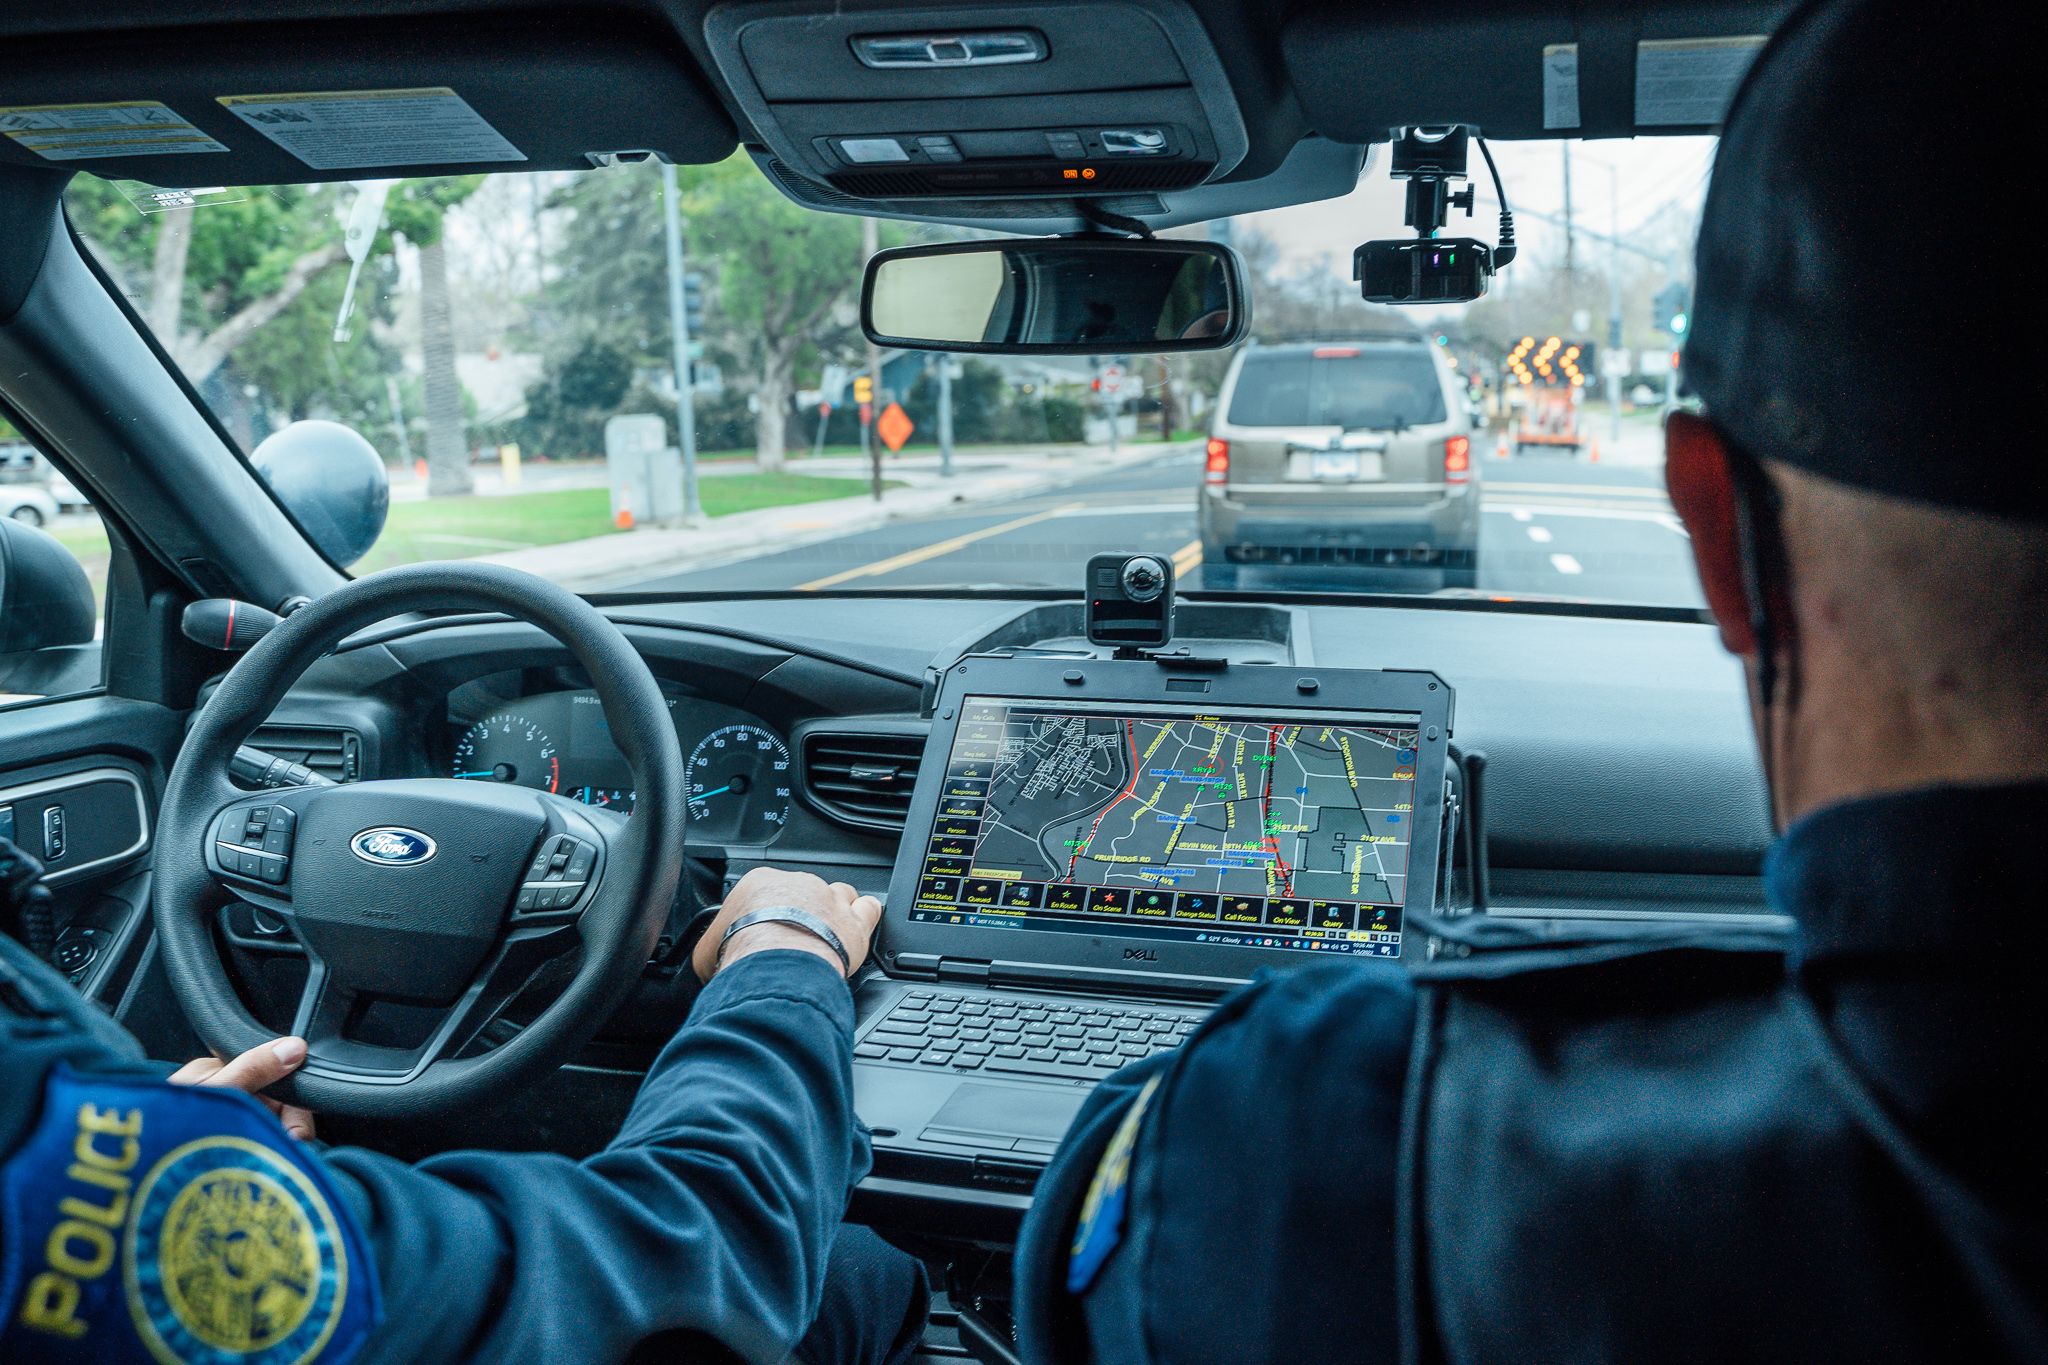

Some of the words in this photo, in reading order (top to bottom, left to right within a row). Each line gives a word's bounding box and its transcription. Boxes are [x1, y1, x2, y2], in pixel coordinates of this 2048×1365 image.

[503, 724, 511, 733] 4
[481, 729, 489, 739] 3
[526, 731, 534, 741] 5
[736, 733, 748, 741] 80
[714, 740, 725, 748] 60
[757, 741, 772, 750] 100
[466, 745, 474, 755] 2
[540, 749, 548, 758] 6
[697, 758, 708, 767] 40
[1236, 756, 1244, 765] ST
[1340, 736, 1354, 771] STOCKTON
[1348, 771, 1359, 789] BLVD
[773, 761, 787, 770] 120
[544, 776, 552, 785] 7
[693, 784, 703, 792] 20
[776, 788, 790, 797] 140
[951, 788, 981, 796] Responses
[1240, 789, 1247, 799] ST
[703, 809, 710, 817] 0
[763, 812, 777, 820] 160
[946, 807, 977, 816] Messaging
[1228, 818, 1235, 828] ST
[1164, 820, 1184, 854] FREEPORT
[365, 833, 416, 856] Ford
[1094, 854, 1138, 863] FRUITRIDGE
[1351, 845, 1363, 884] LAWRENCE
[931, 866, 962, 875] Command
[1160, 877, 1176, 886] AVE
[1267, 860, 1277, 895] FRANKLIN
[1351, 884, 1360, 895] DR
[936, 893, 954, 901] Status
[967, 896, 992, 904] Queued
[1176, 910, 1198, 918] Change
[1198, 911, 1216, 919] Status
[1238, 914, 1258, 922] Forms
[1284, 917, 1301, 925] View
[1322, 920, 1344, 928] Query
[1371, 923, 1389, 931] Map
[1123, 948, 1158, 961] DELL
[19, 1102, 144, 1340] POLICE
